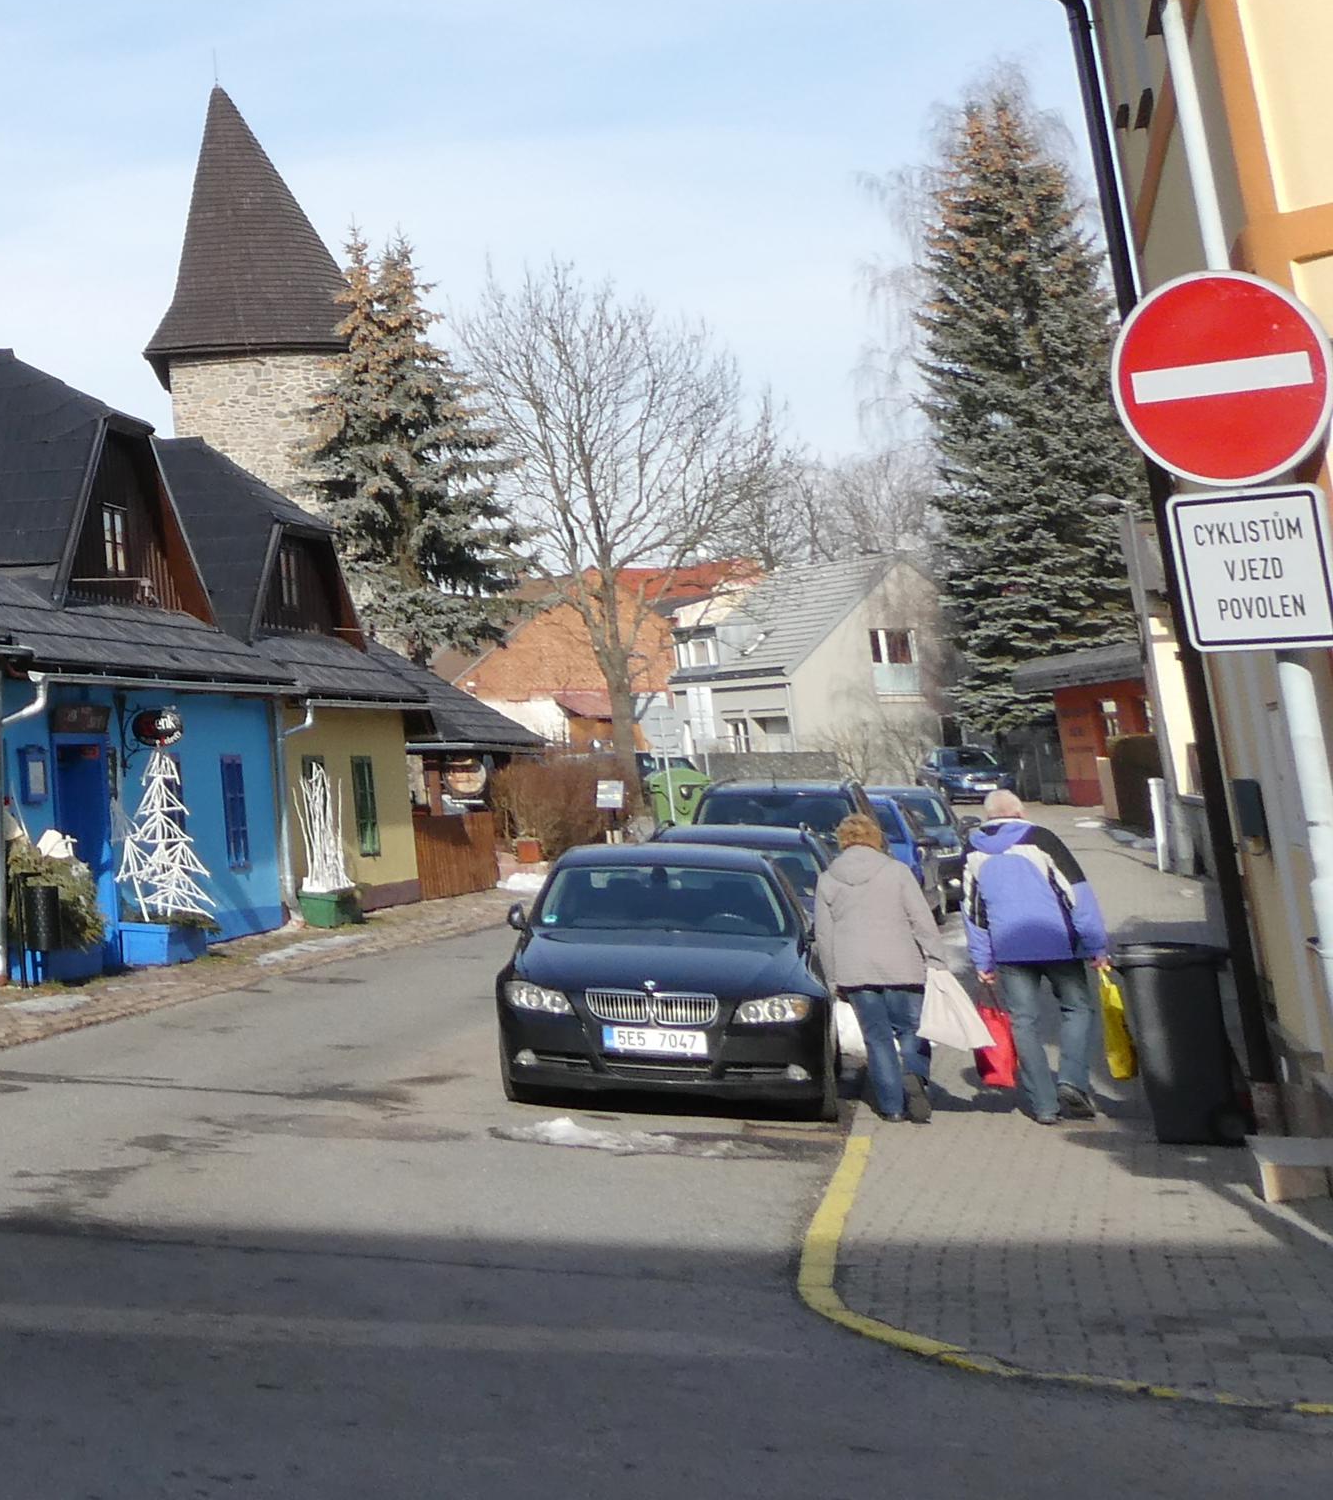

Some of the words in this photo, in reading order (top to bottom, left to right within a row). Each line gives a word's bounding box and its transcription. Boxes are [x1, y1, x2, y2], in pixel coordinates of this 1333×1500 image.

[1193, 510, 1303, 546] CYKLISTŮM
[1223, 557, 1284, 582] VJEZD
[1217, 593, 1306, 621] POVOLEN
[617, 1030, 646, 1047] 5E5
[659, 1032, 697, 1050] 7047
